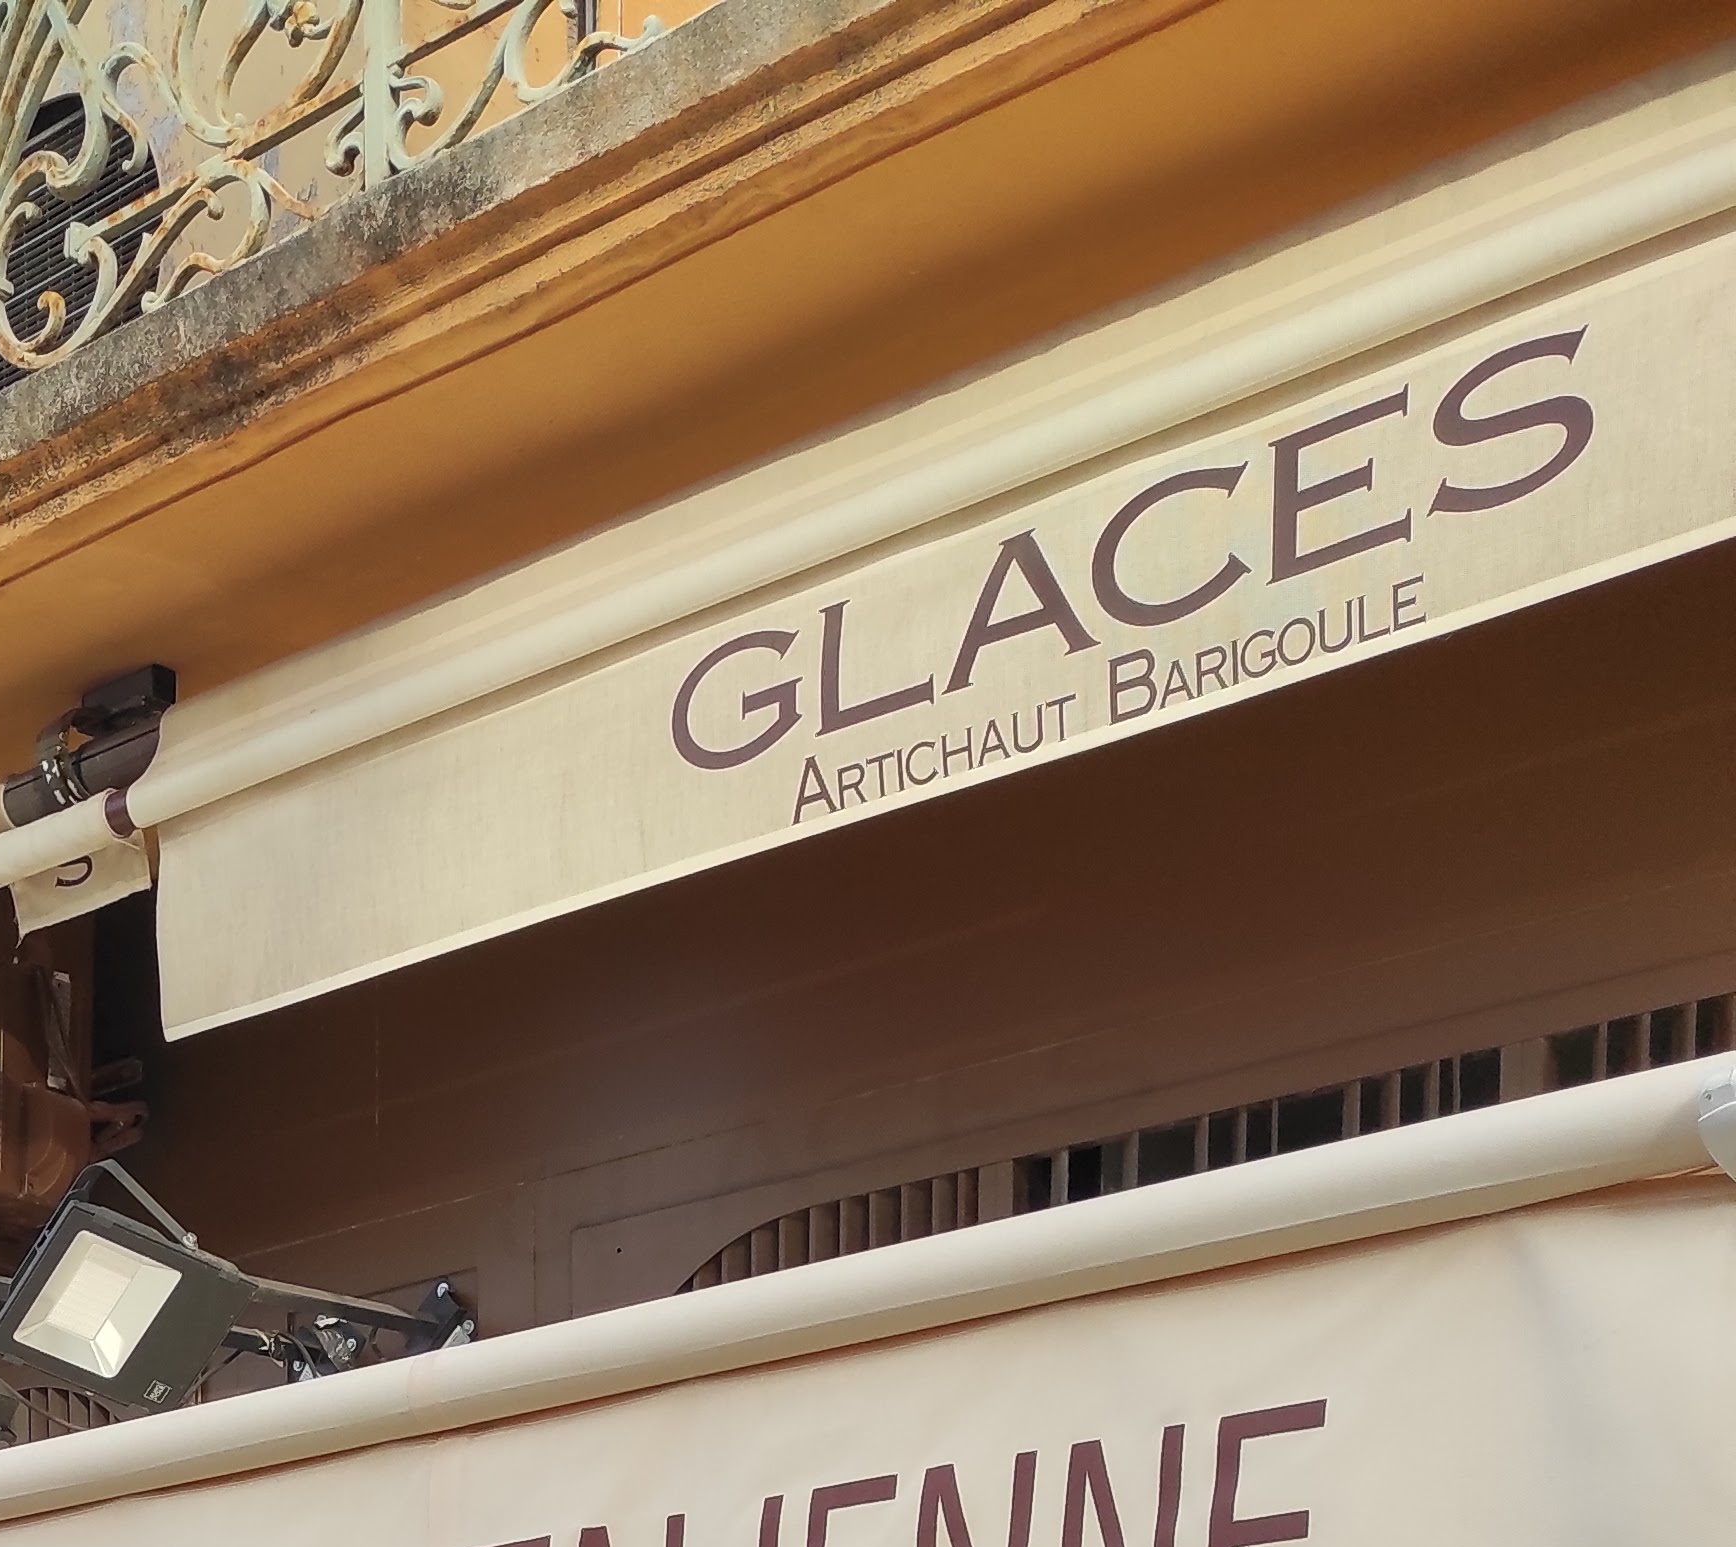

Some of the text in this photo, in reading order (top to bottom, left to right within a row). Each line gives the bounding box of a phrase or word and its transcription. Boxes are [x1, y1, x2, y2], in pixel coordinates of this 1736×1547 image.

[672, 325, 1594, 771] GLACES
[791, 575, 1426, 824] ARTICHAUT BARIGOULE
